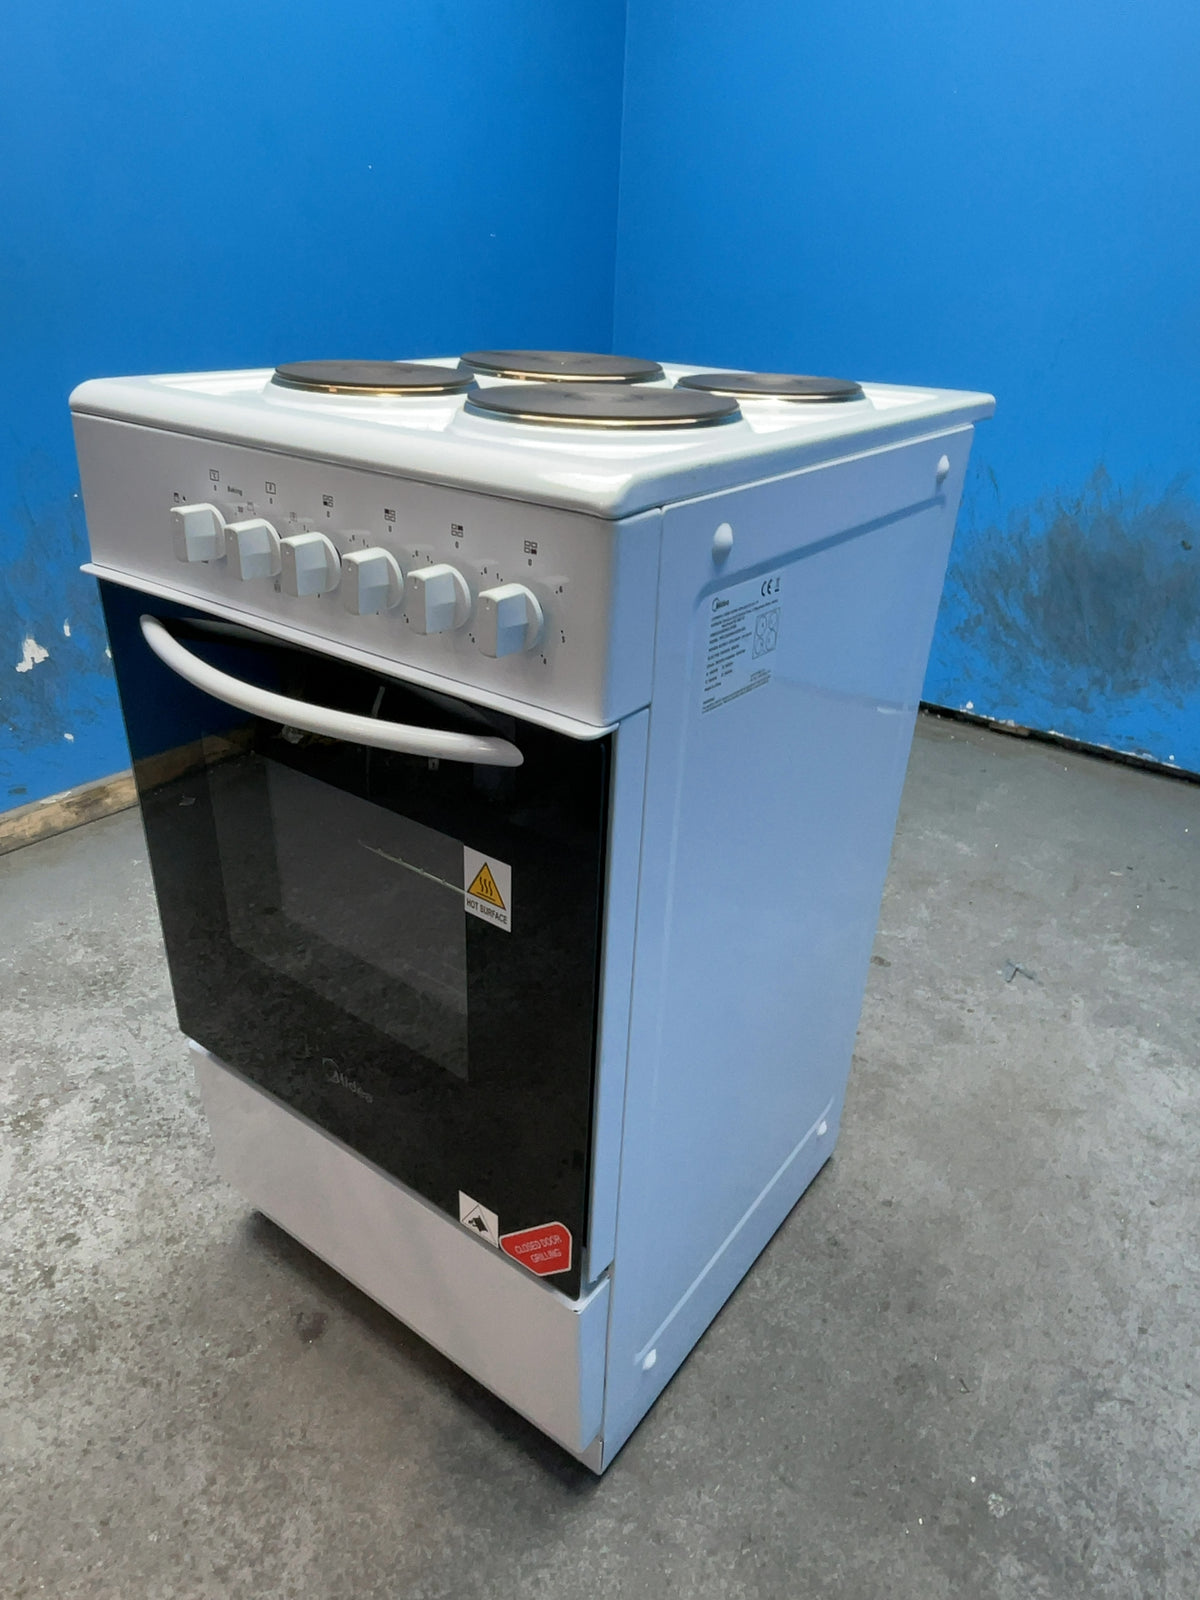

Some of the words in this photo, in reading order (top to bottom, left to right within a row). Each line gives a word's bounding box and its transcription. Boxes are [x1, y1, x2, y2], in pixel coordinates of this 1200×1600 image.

[466, 898, 479, 910] HOT
[480, 904, 507, 924] SURFACE
[514, 1240, 541, 1254] CLOSED
[540, 1235, 562, 1247] DOOR
[530, 1248, 561, 1262] GRILLING
